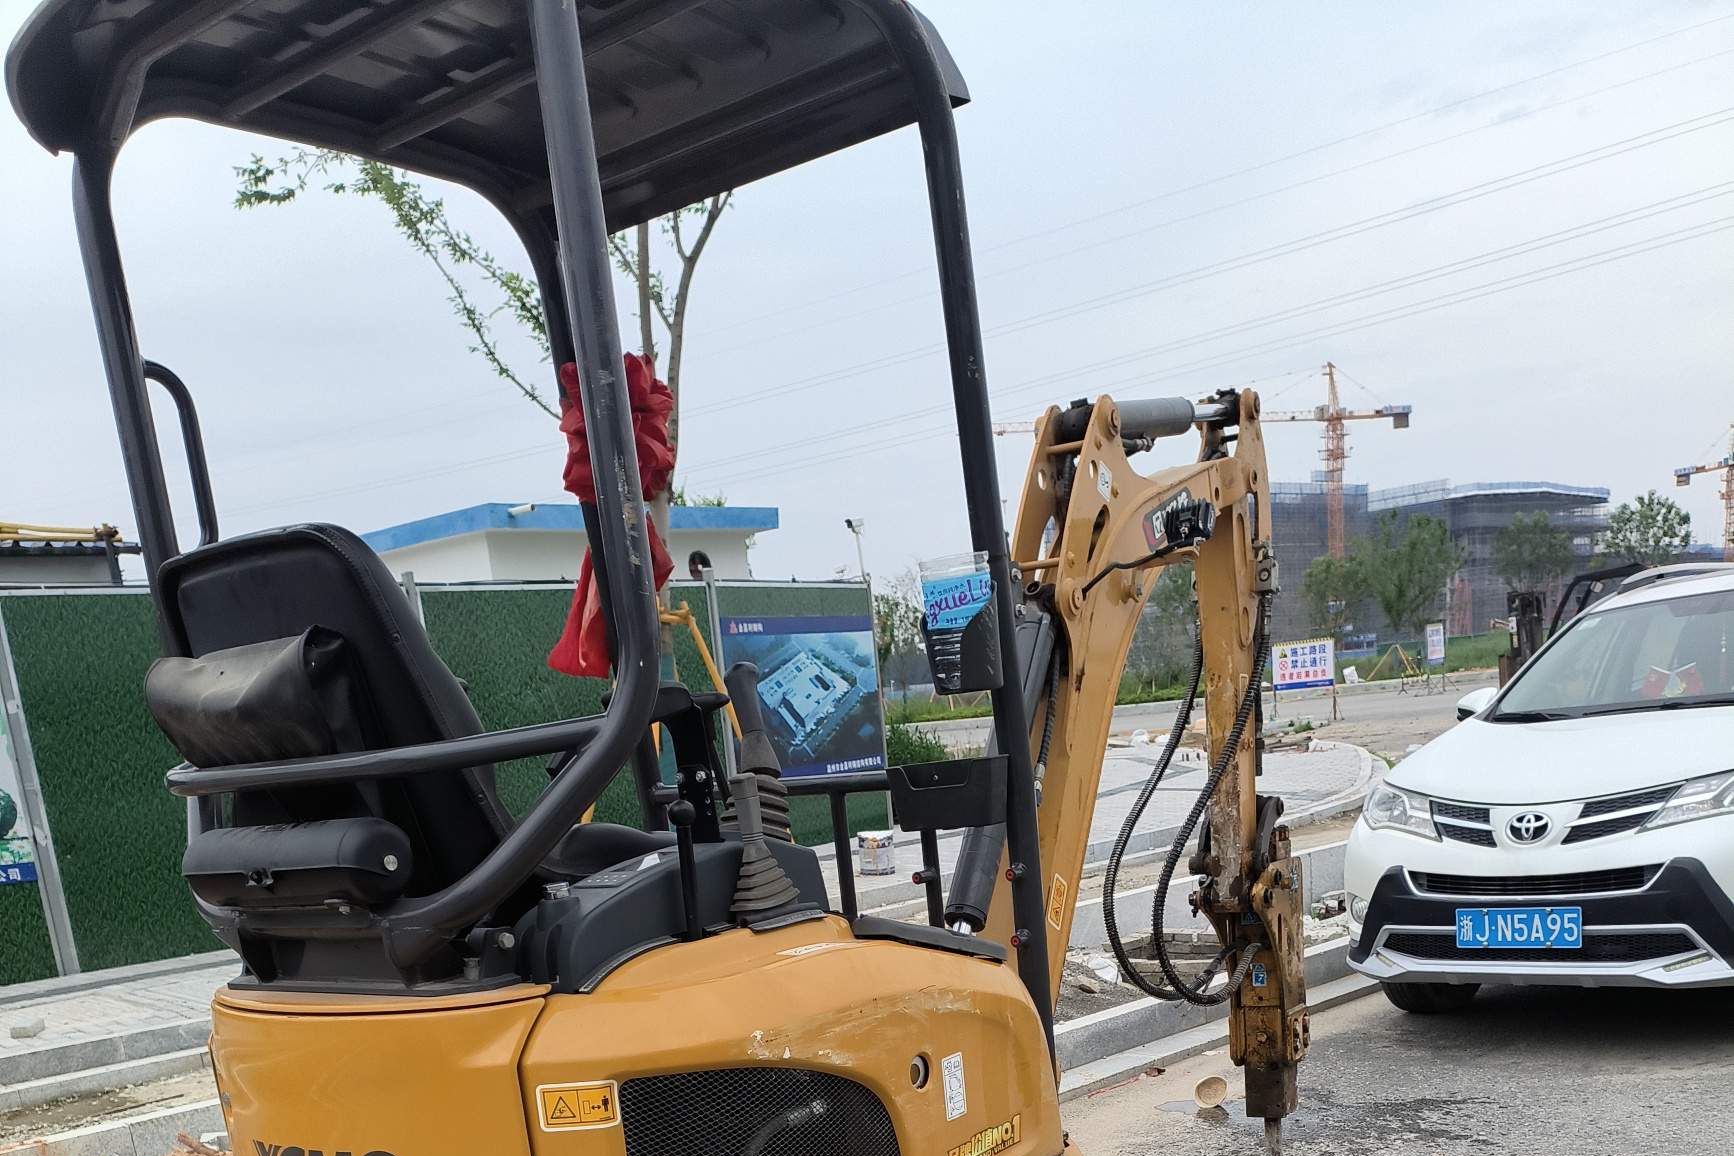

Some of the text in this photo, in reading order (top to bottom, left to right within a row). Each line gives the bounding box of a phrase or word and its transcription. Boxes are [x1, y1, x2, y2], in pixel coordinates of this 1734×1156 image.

[1290, 644, 1327, 657] 施工路段
[1291, 656, 1327, 669] 禁止通行
[993, 1138, 1014, 1154] VALUE
